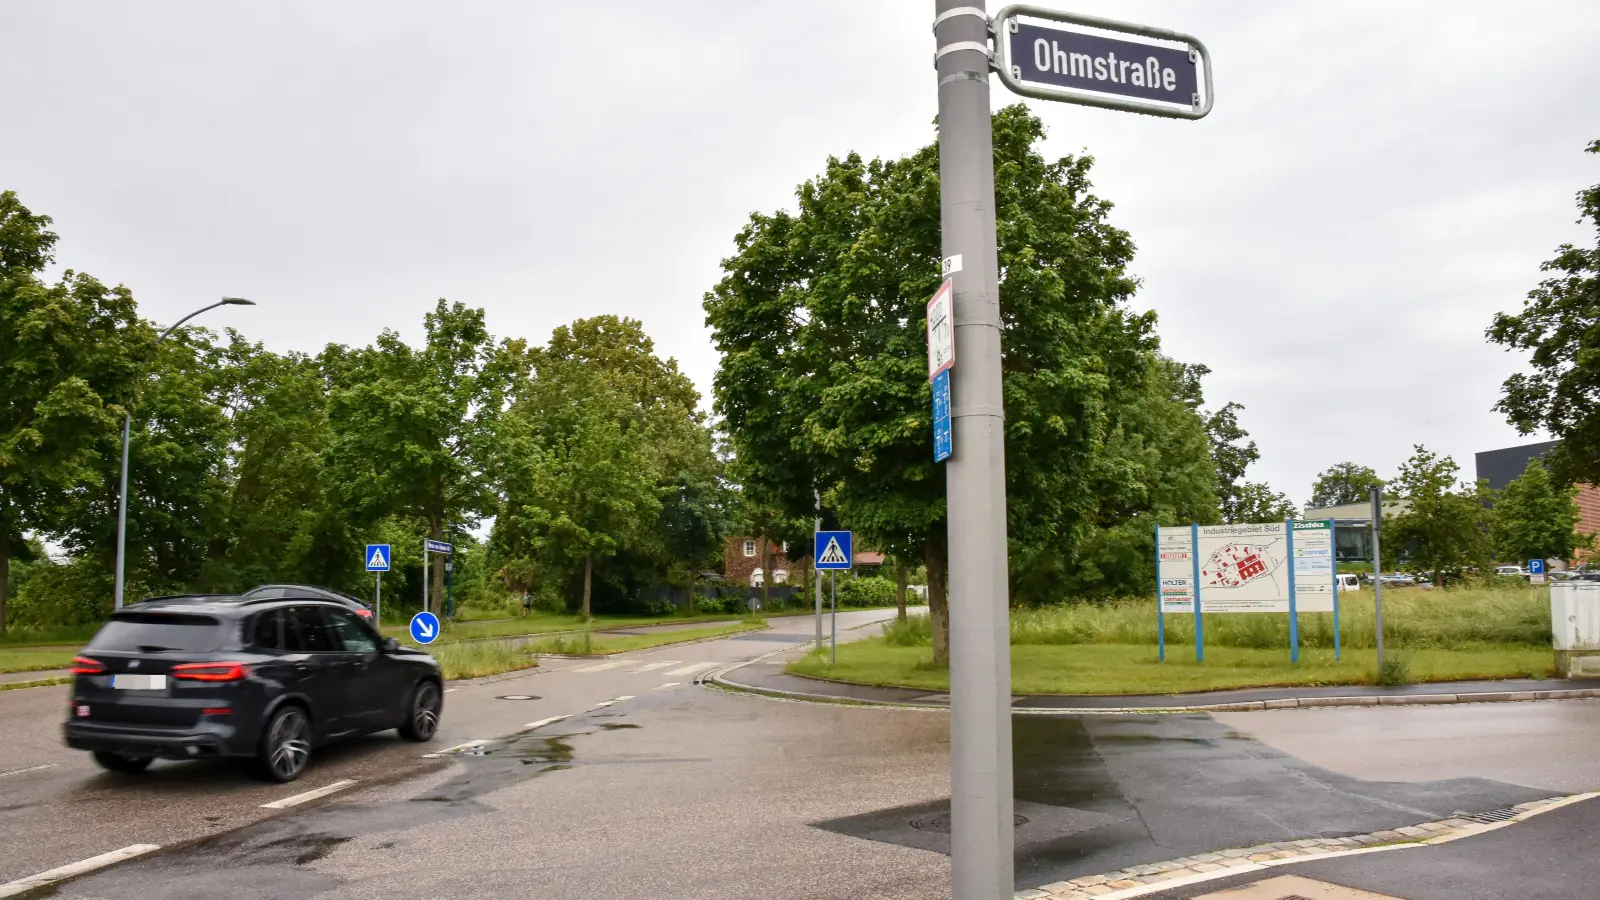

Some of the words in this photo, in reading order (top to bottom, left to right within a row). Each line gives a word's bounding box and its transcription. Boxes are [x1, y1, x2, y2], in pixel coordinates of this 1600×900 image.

[1034, 38, 1177, 92] Ohmstraße
[1203, 526, 1263, 535] Industriegebiet
[1531, 561, 1541, 573] P
